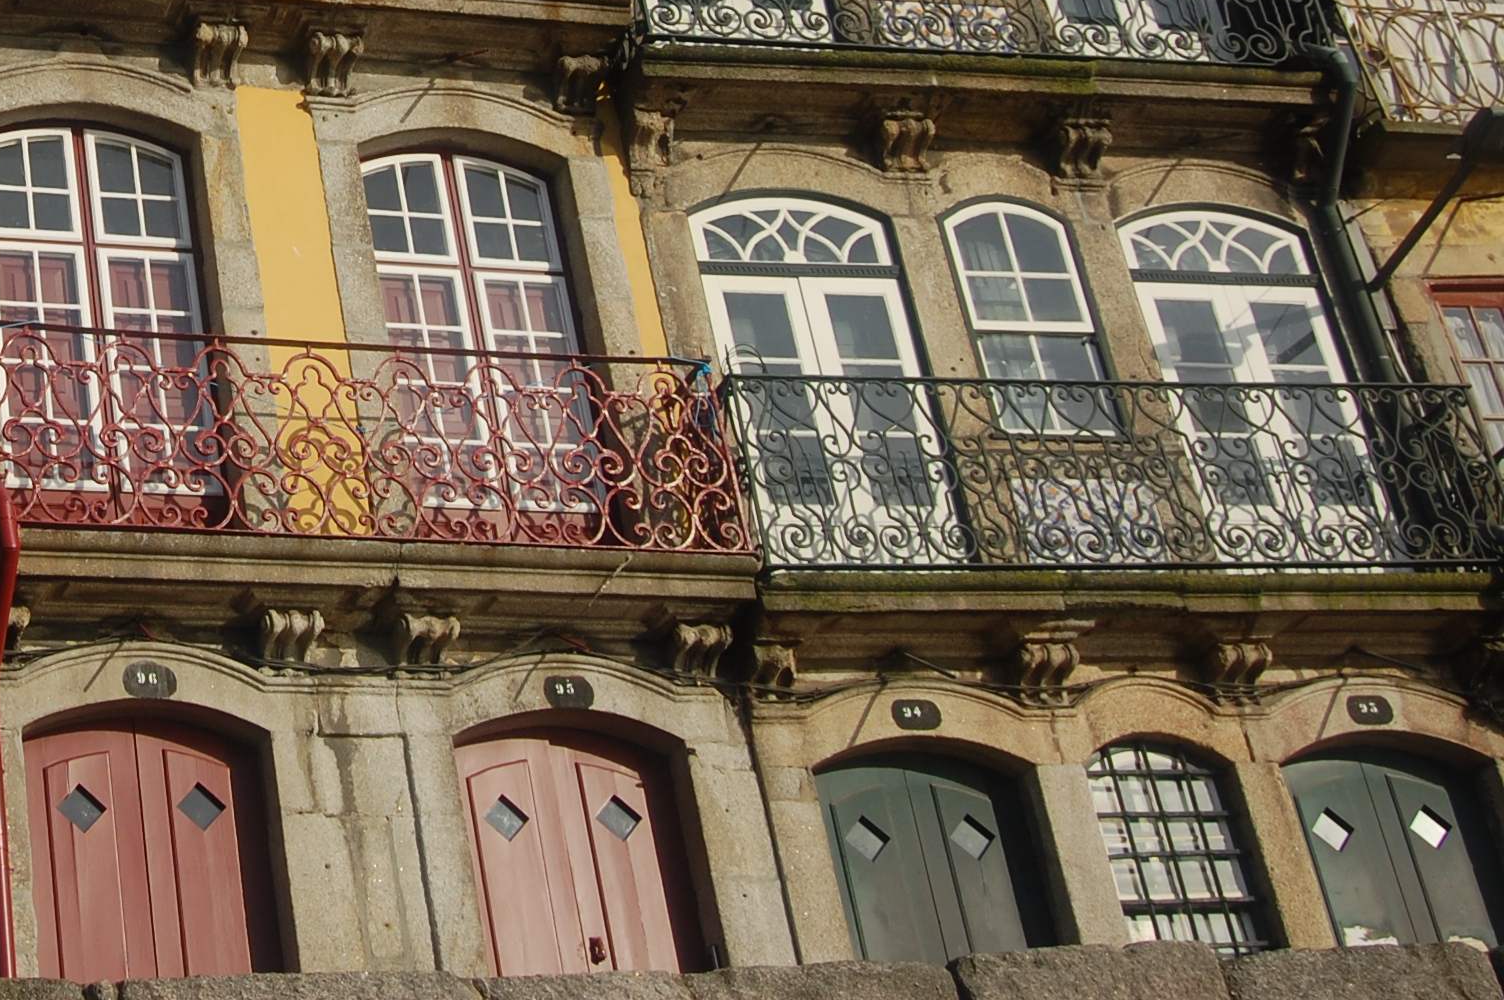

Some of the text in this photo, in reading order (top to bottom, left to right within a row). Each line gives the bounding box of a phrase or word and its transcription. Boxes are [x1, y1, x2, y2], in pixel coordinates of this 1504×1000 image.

[136, 672, 158, 685] 96
[555, 682, 575, 695] 95
[902, 705, 922, 718] 94
[1358, 701, 1379, 714] 93
